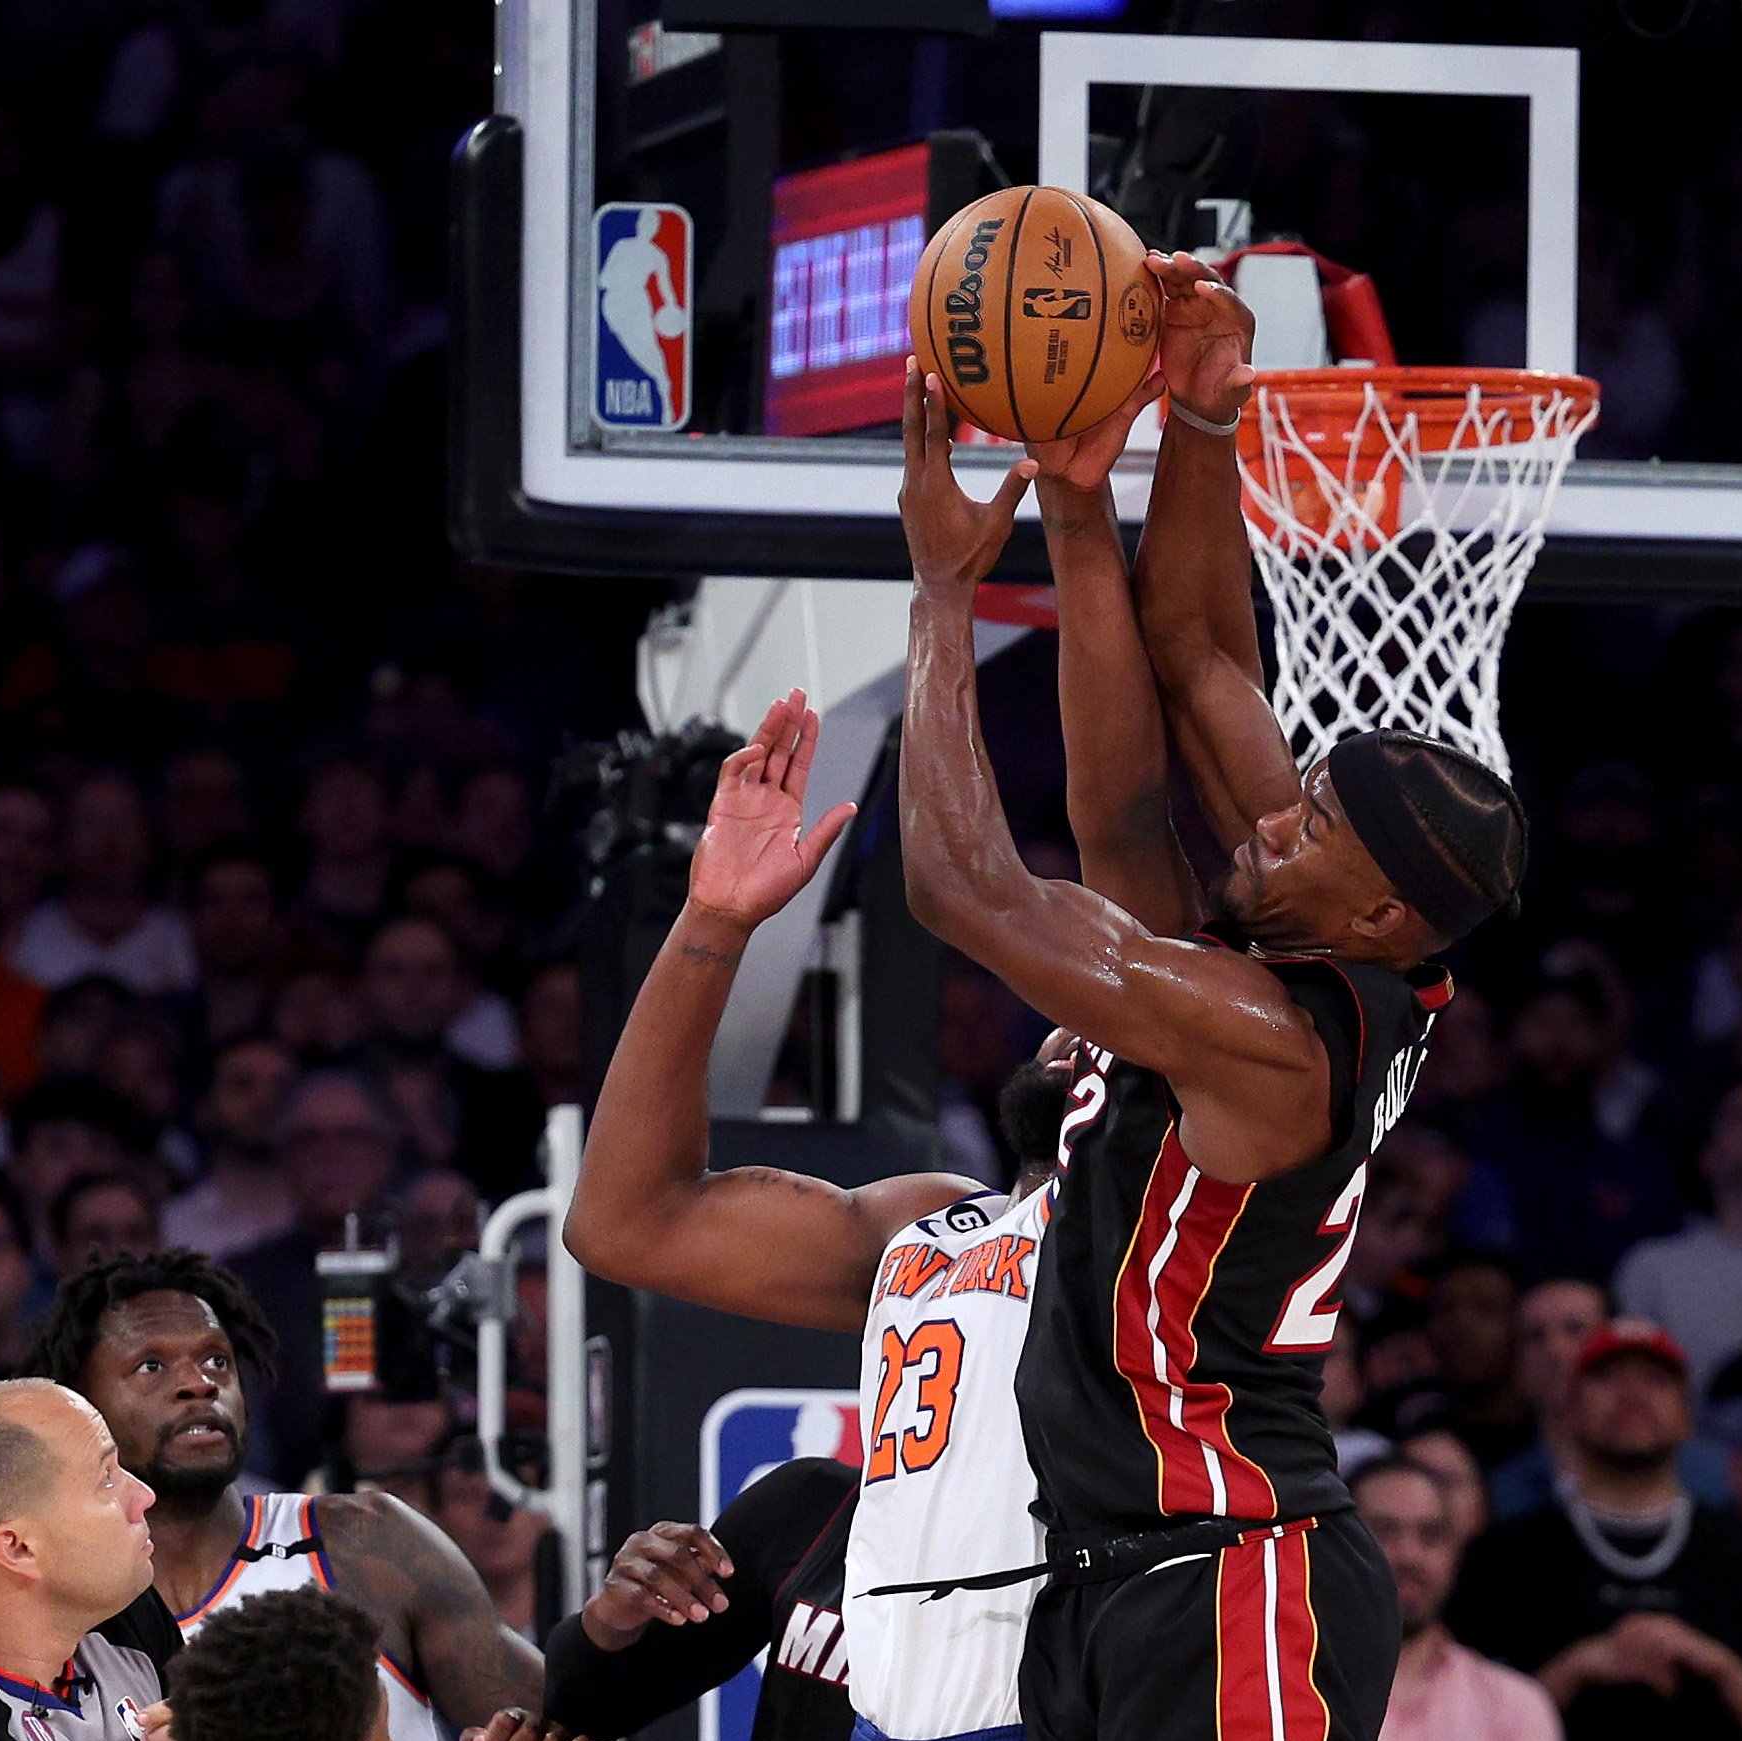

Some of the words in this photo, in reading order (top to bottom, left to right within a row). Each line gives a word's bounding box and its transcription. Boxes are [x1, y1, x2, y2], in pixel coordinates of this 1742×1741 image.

[945, 218, 1006, 388] Wilson
[605, 379, 653, 415] NBA
[928, 1234, 1040, 1303] YORK
[1261, 1158, 1369, 1352] 2
[864, 1317, 965, 1486] 23
